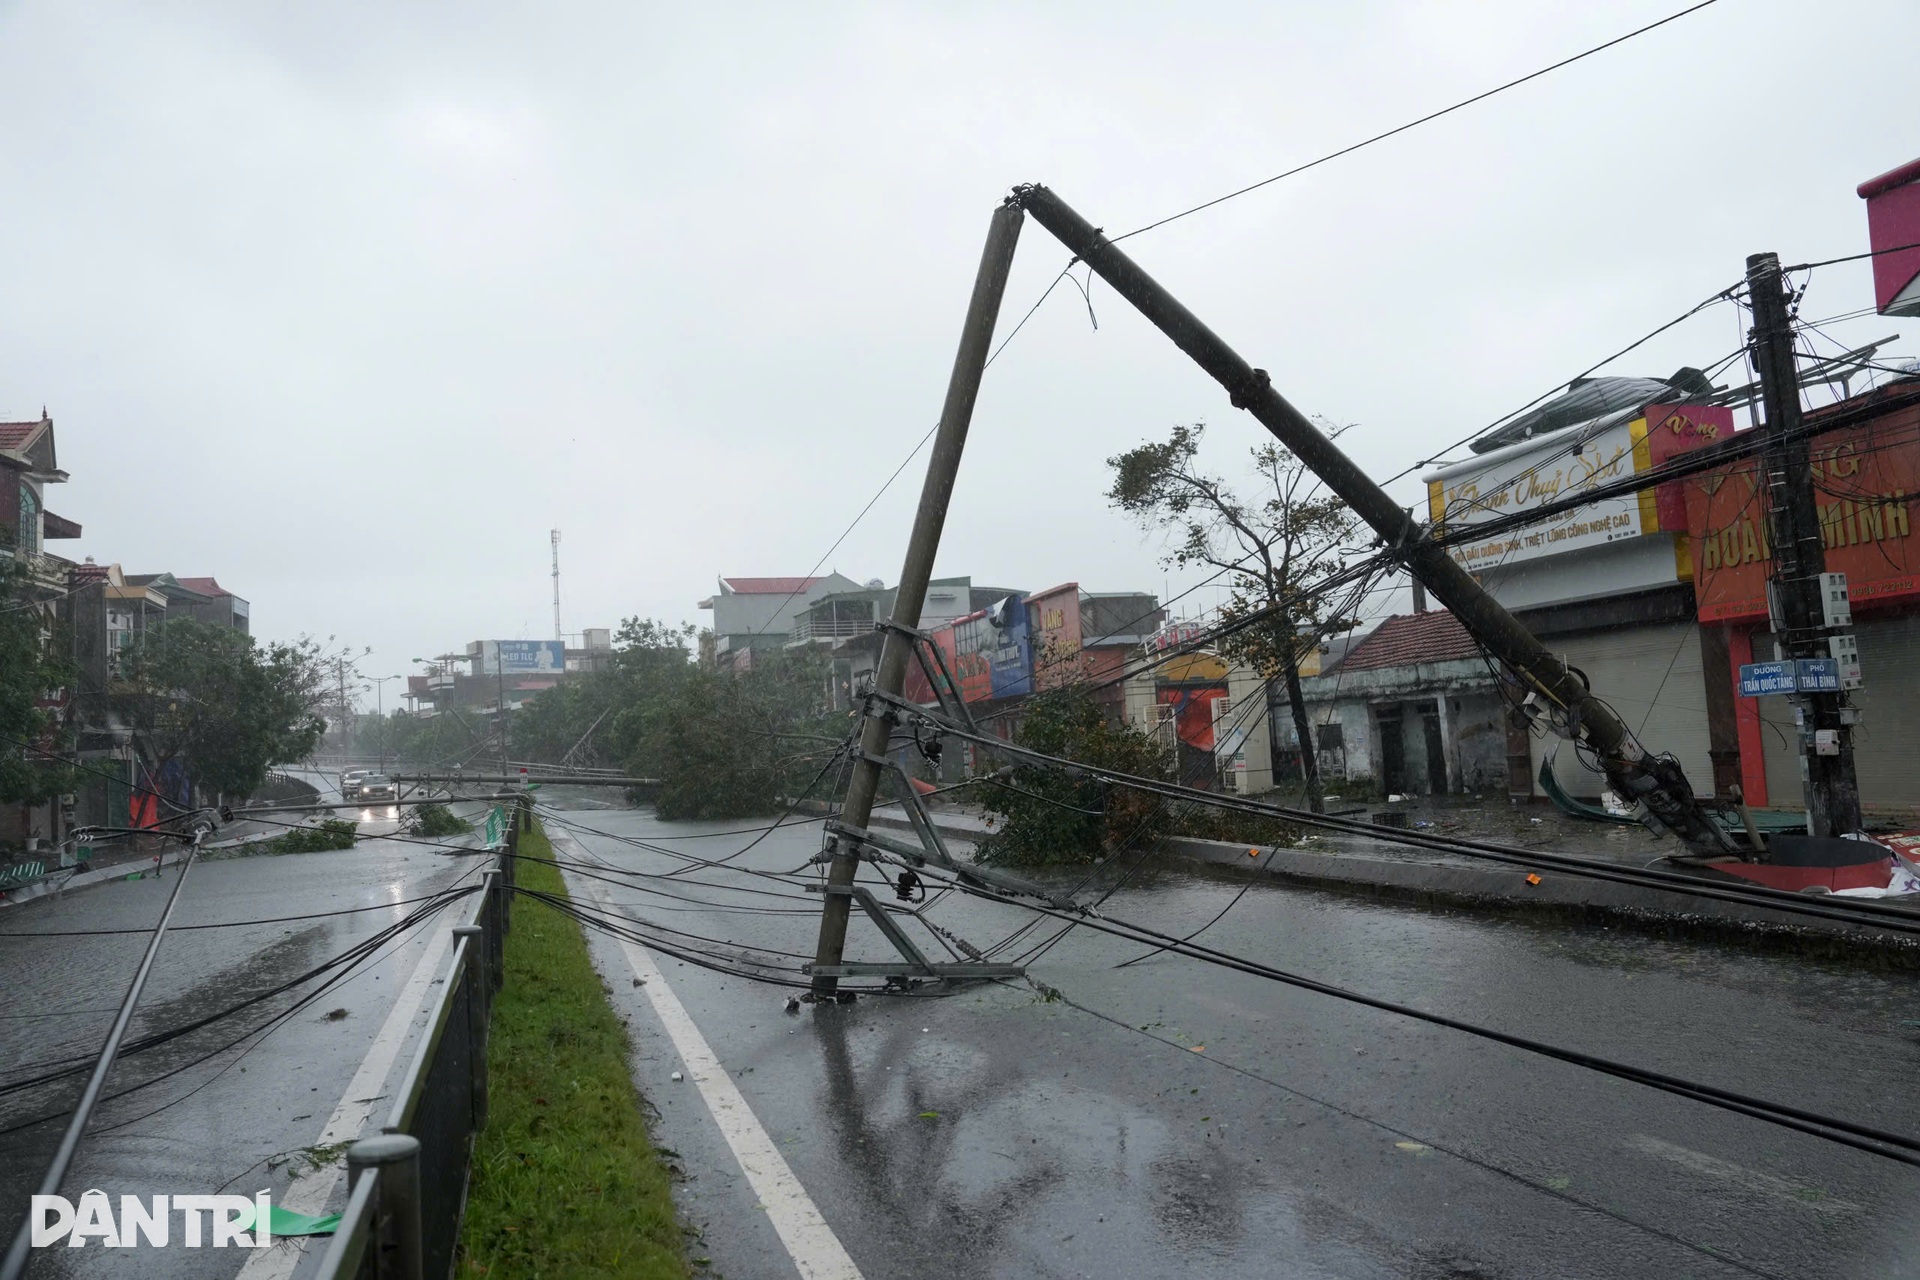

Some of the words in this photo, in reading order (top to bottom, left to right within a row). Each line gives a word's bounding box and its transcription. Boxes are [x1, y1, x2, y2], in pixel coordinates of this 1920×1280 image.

[1568, 523, 1589, 538] CÔNG
[1590, 516, 1612, 532] NGHỆ
[1613, 513, 1631, 528] CAO
[1753, 665, 1782, 675] ĐƯỜNG
[1810, 662, 1825, 672] PHỐ
[1760, 675, 1777, 692] QUỐC
[1802, 674, 1818, 688] THÁI
[1819, 675, 1836, 688] BÌNH
